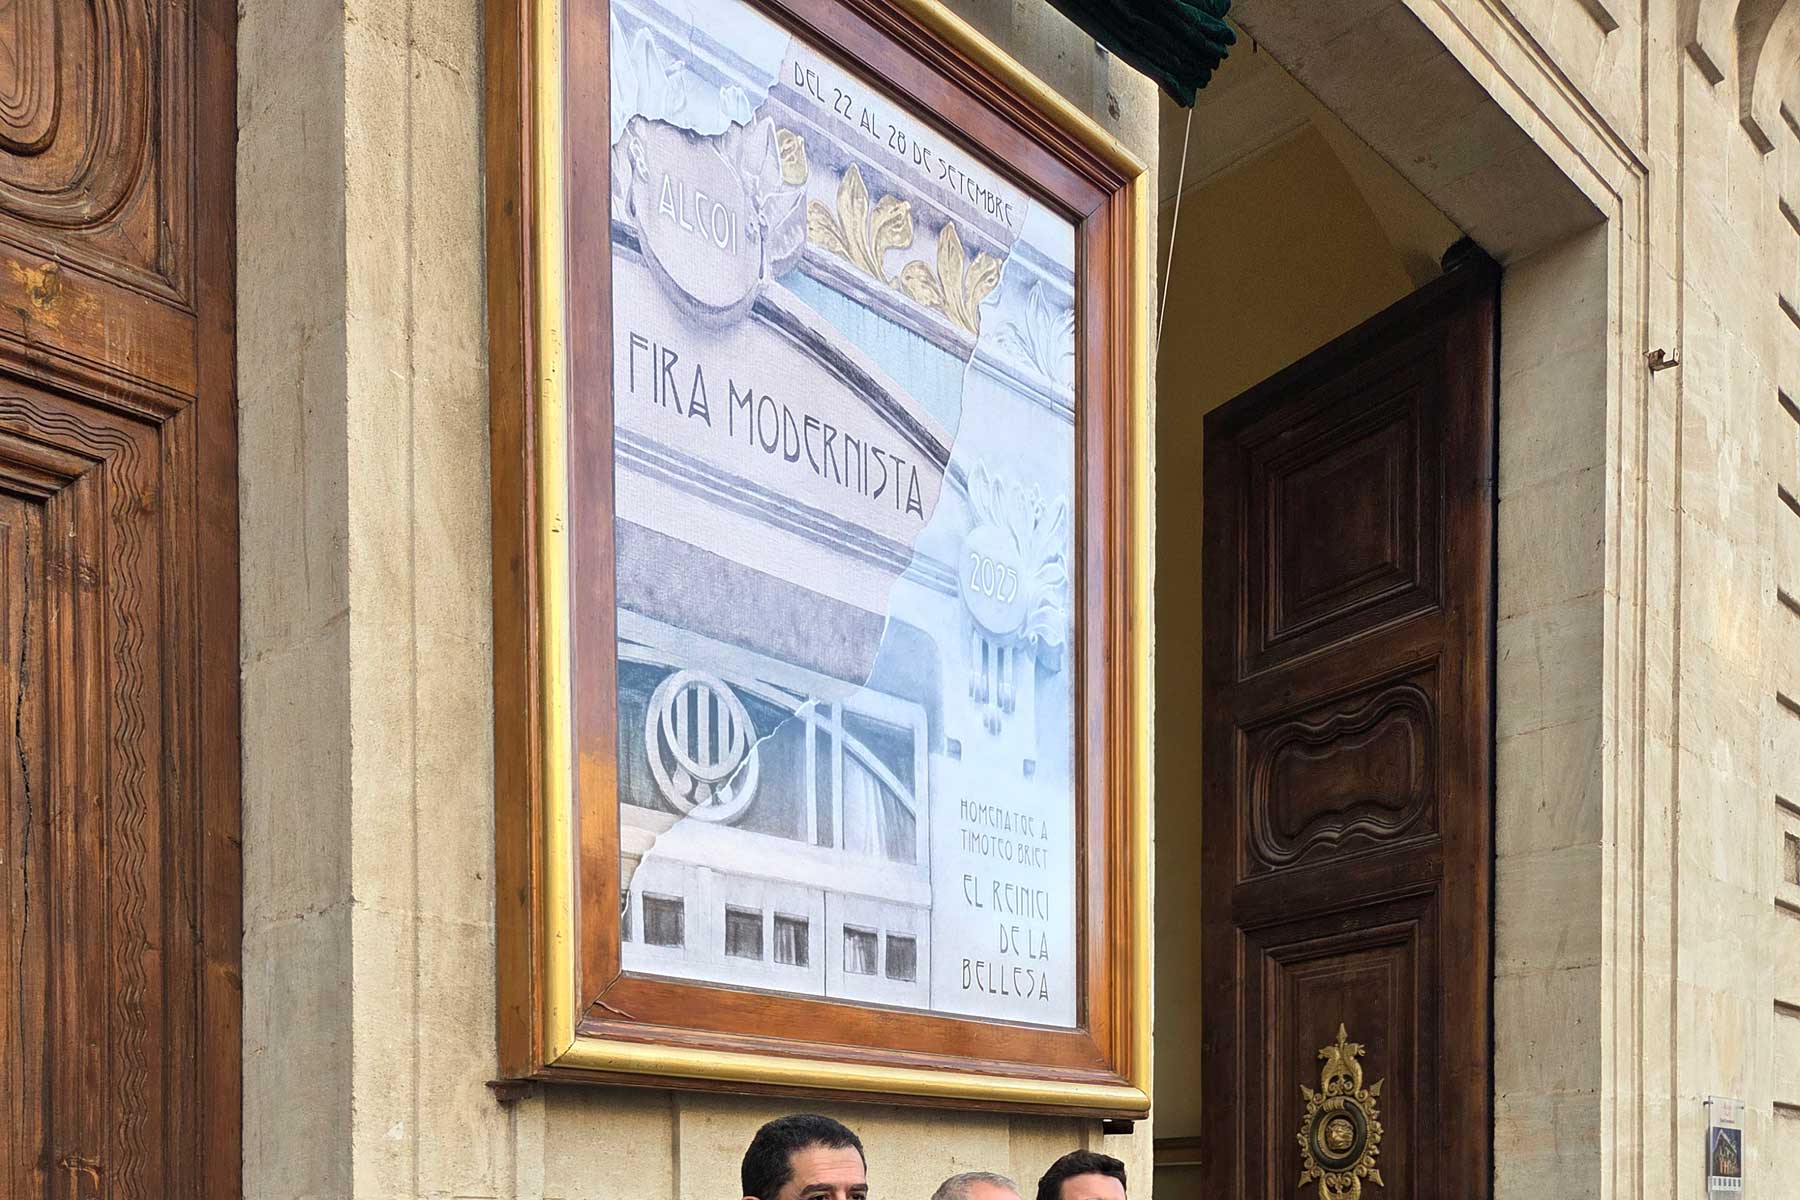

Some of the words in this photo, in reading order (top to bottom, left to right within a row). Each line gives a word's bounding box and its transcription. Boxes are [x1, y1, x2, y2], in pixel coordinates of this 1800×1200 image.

[794, 61, 825, 102] DEL
[834, 88, 852, 120] 22
[860, 108, 880, 139] AL
[888, 125, 907, 154] 28
[913, 141, 932, 173] DE
[938, 158, 1013, 227] SETEMBRE
[658, 174, 736, 256] ALCOI
[630, 331, 711, 427] FIRA
[729, 378, 924, 521] MODERNISTA
[970, 553, 1018, 604] 2025
[960, 799, 1034, 837] HOMENATGE
[1041, 821, 1048, 840] A
[961, 828, 1013, 861] TIMOTEO
[1018, 843, 1048, 870] BRIET
[963, 874, 983, 908] EL
[993, 880, 1048, 922] REINICI
[1000, 923, 1019, 956] DE
[1029, 929, 1048, 961] LA
[962, 958, 1048, 1001] BELLESA
